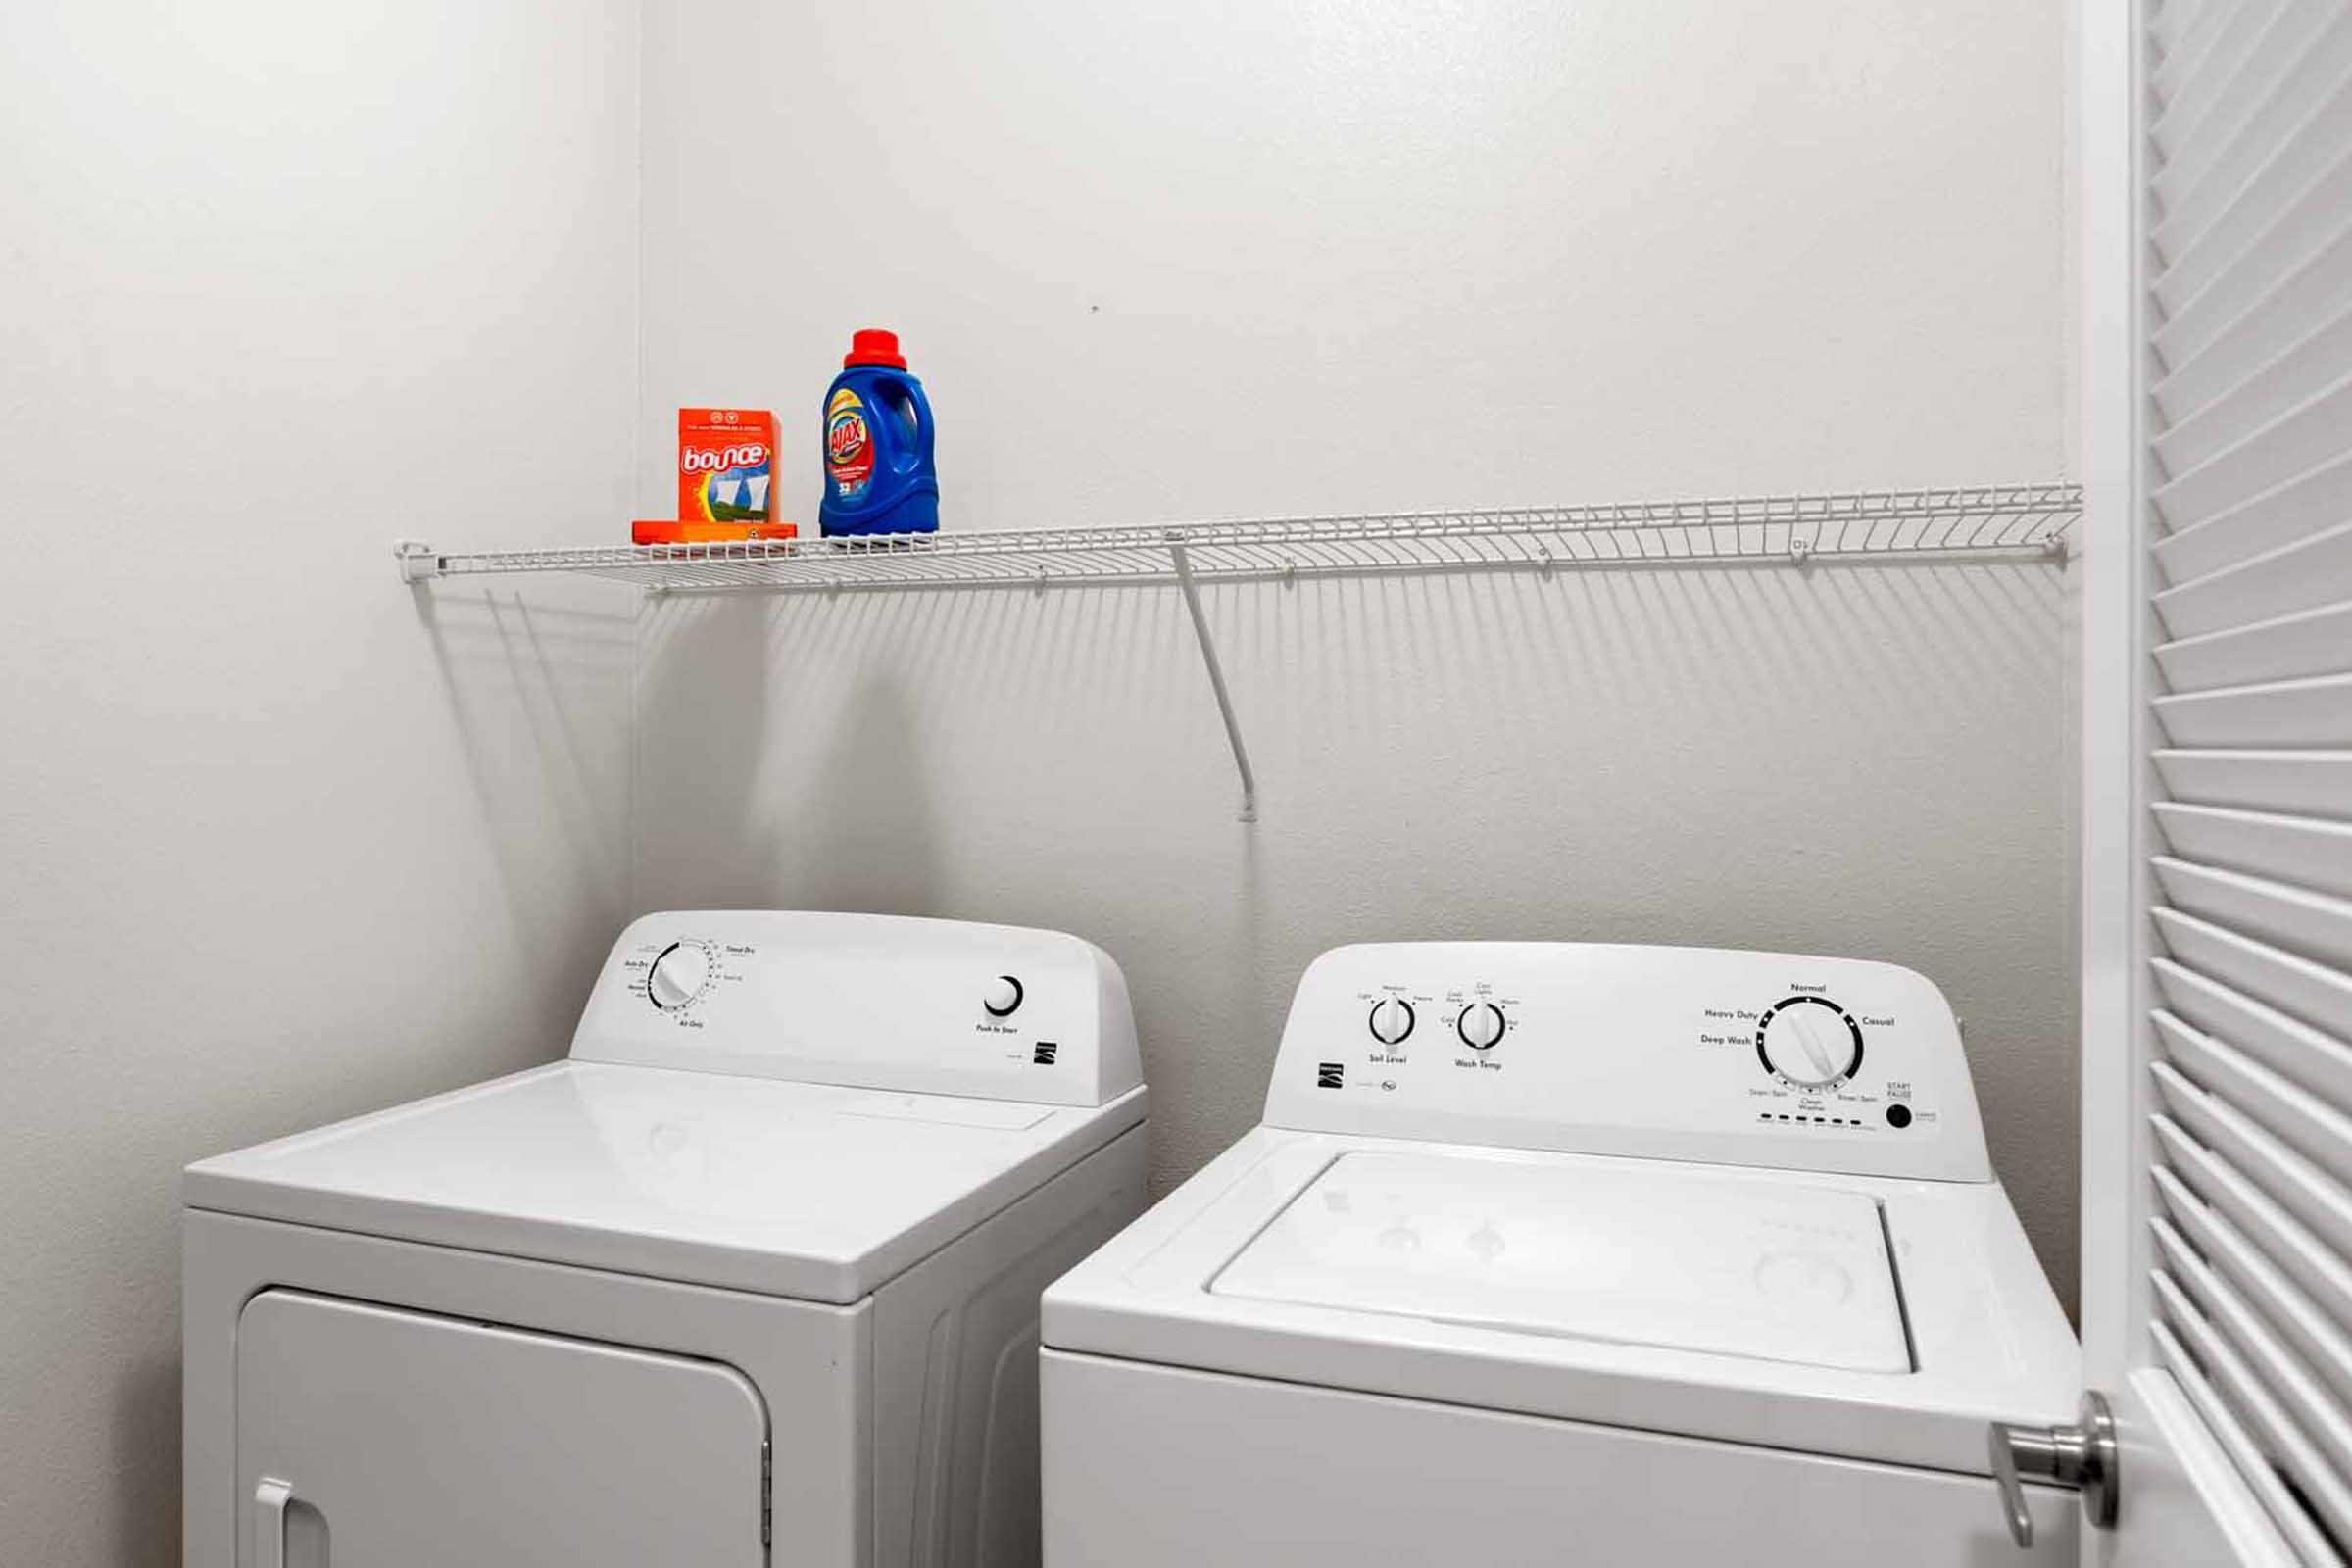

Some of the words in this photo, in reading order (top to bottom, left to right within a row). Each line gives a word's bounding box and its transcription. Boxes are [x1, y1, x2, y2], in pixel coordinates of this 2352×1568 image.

[831, 416, 862, 454] AJAX
[682, 444, 764, 472] bounce
[1790, 983, 1827, 993] Normal
[1704, 1009, 1735, 1020] Heavy
[1736, 1010, 1759, 1021] Duty
[975, 1023, 992, 1032] Push
[1862, 1016, 1895, 1027] Casual
[1700, 1034, 1726, 1046] Deep
[1727, 1036, 1752, 1046] Wash
[1369, 1053, 1385, 1063] Soil
[1386, 1054, 1407, 1064] Level
[1454, 1058, 1478, 1068] Wash
[1479, 1060, 1502, 1072] Temp
